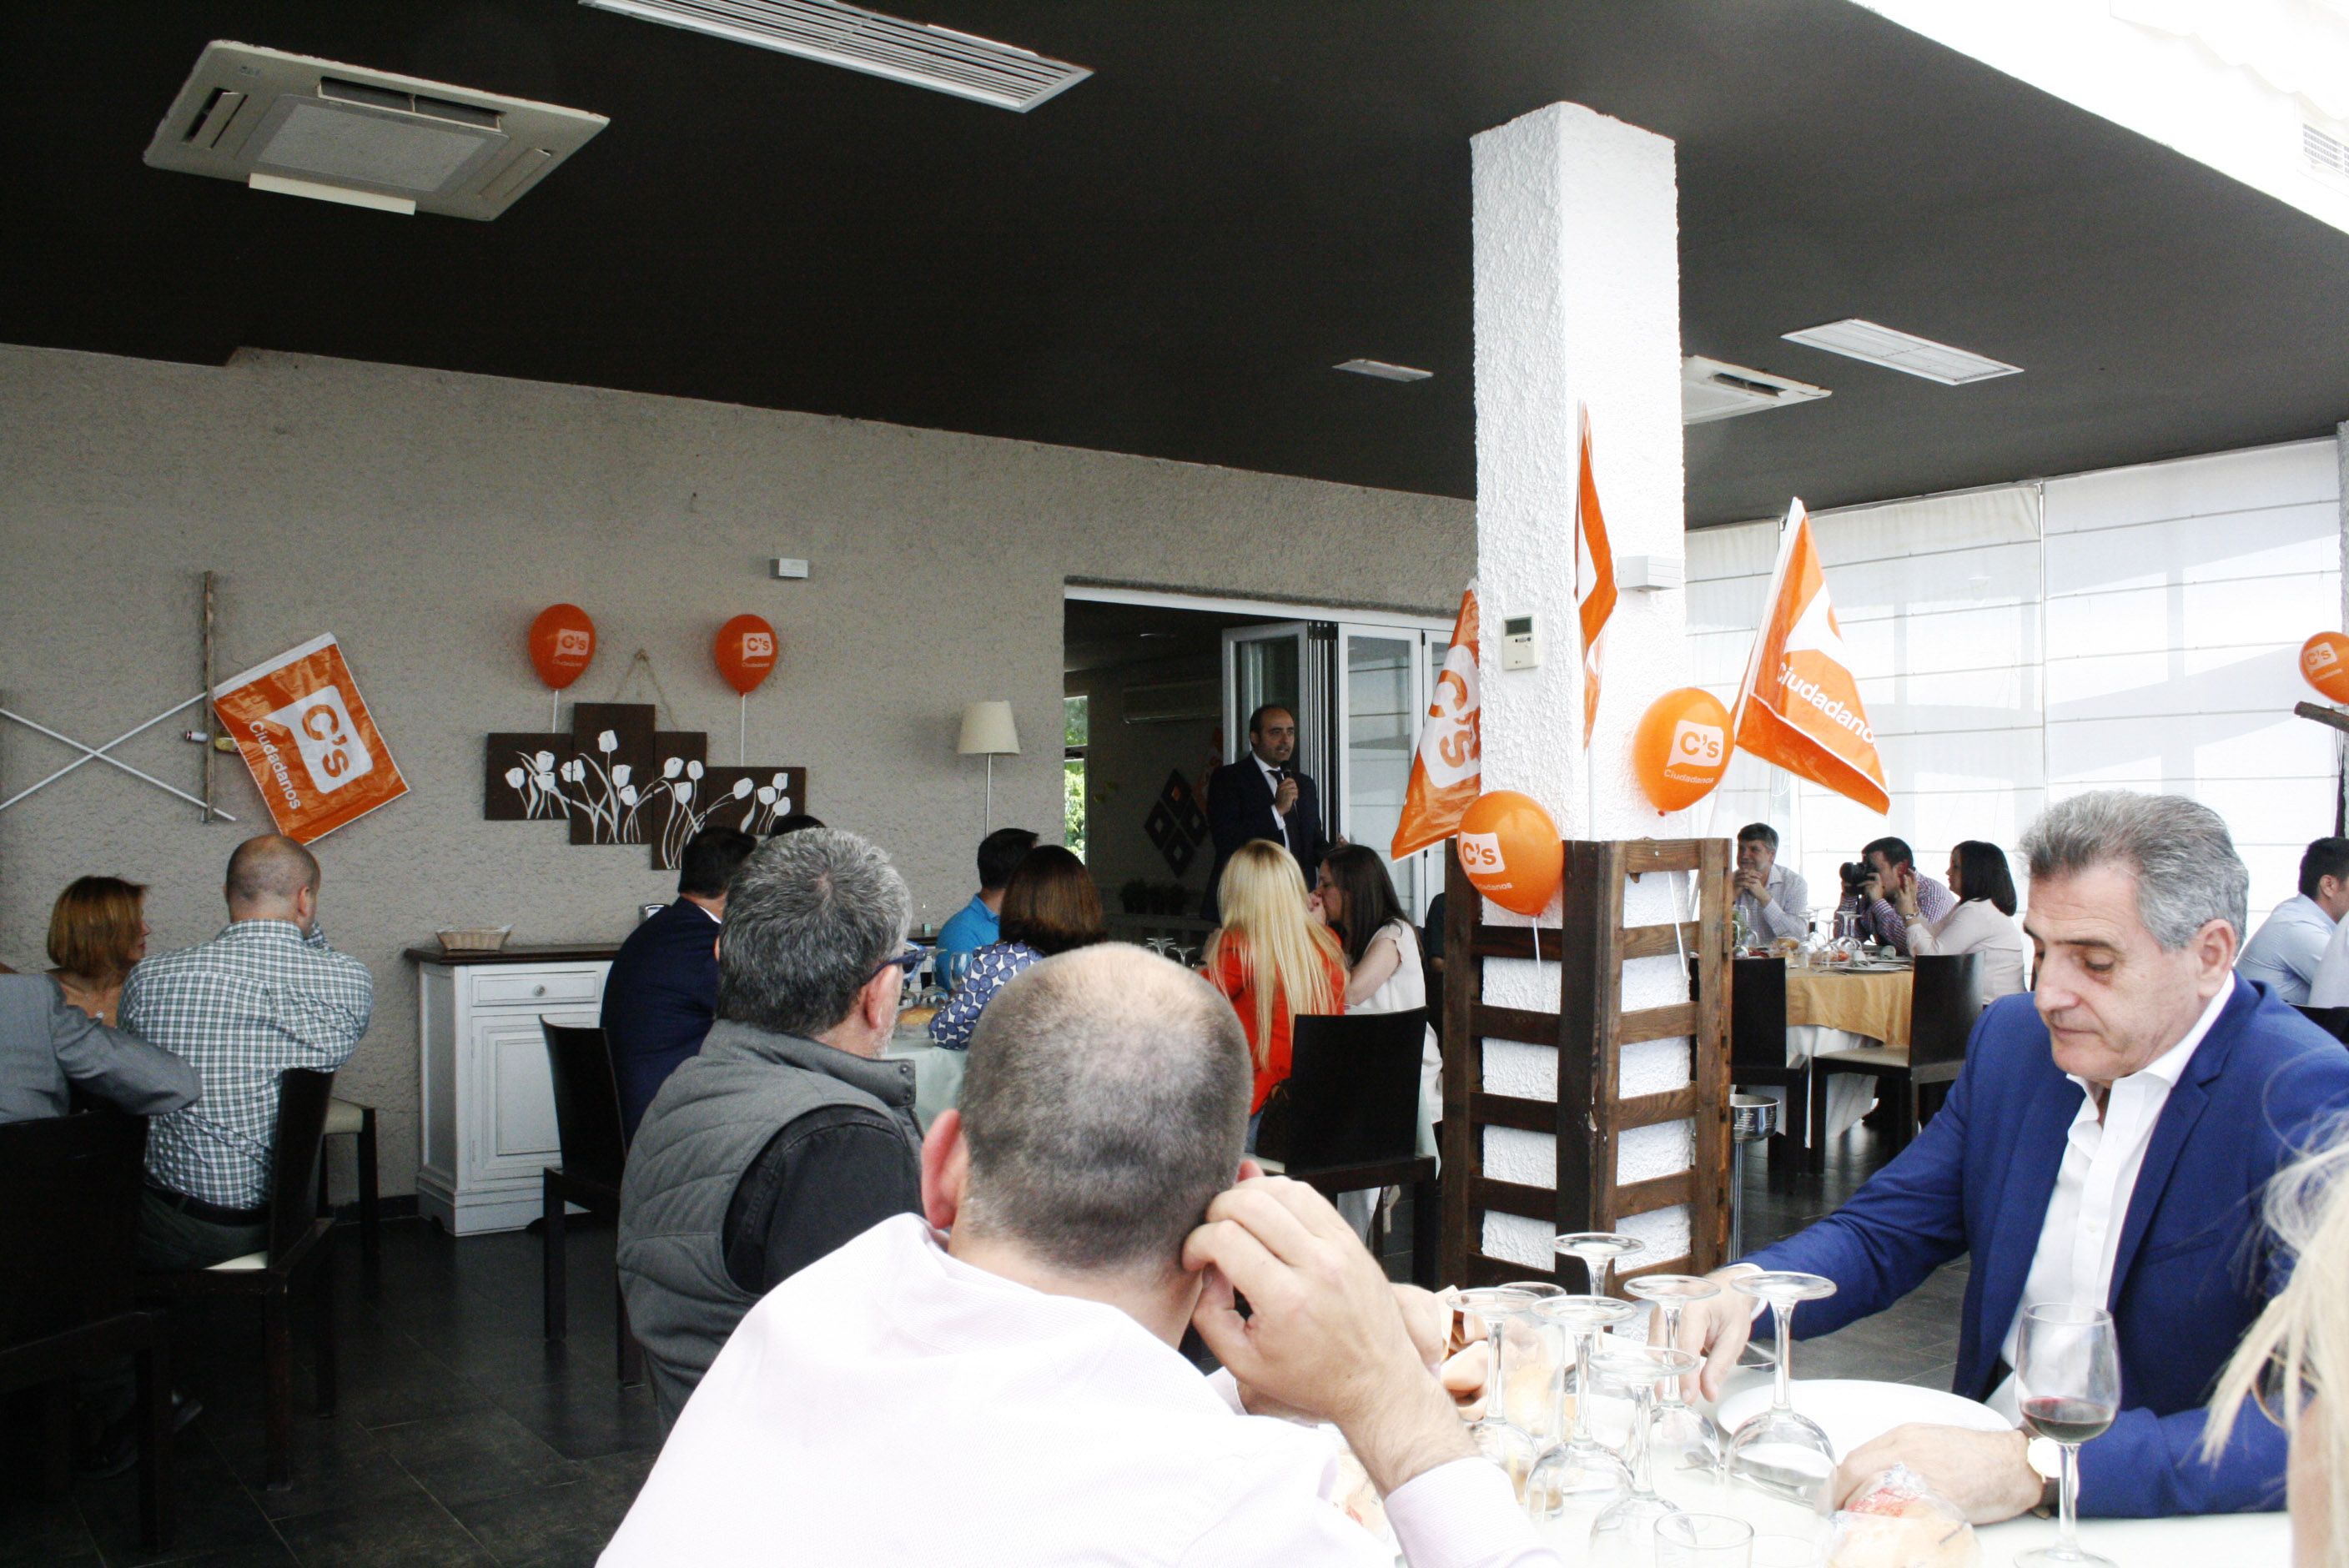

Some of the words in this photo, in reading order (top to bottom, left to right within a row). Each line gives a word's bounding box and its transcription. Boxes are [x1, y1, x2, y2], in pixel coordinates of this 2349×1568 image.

[561, 635, 586, 651] C's
[747, 637, 770, 651] C's
[1777, 661, 1874, 744] Ciudadano
[301, 704, 350, 778] C's
[1680, 731, 1719, 758] C's
[249, 721, 301, 810] Ciudadanos
[1462, 842, 1496, 866] C's
